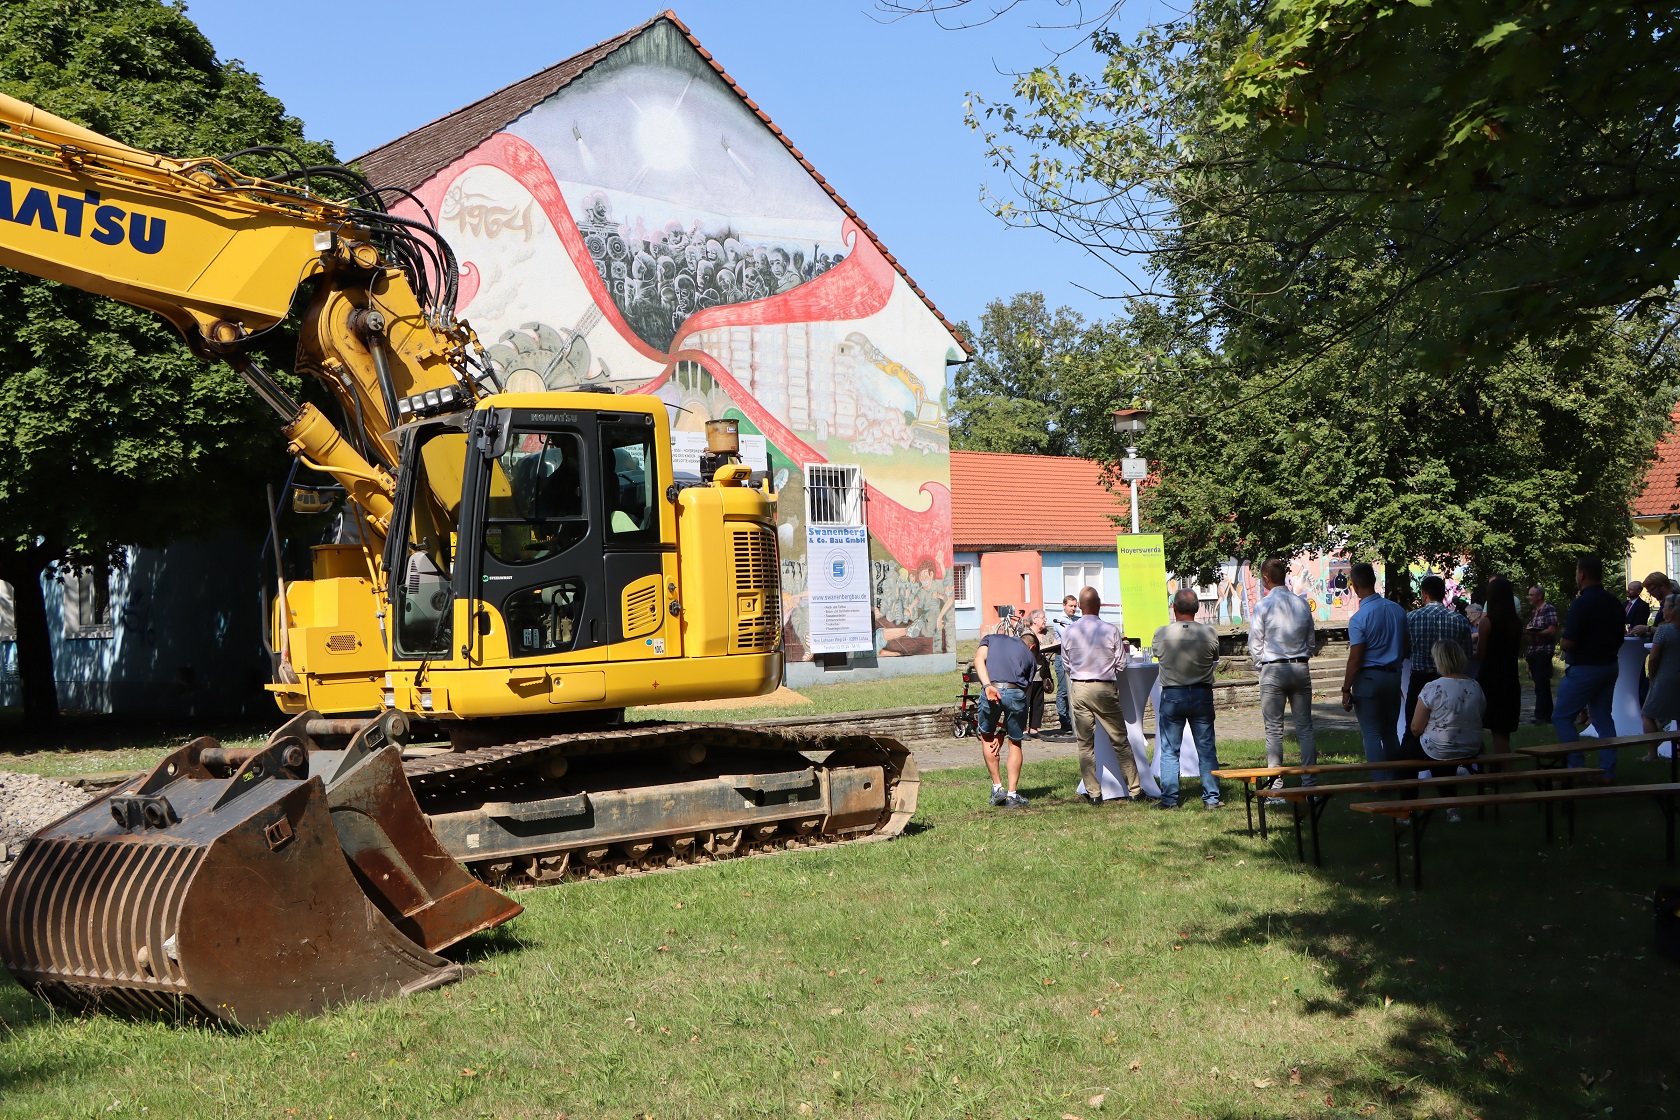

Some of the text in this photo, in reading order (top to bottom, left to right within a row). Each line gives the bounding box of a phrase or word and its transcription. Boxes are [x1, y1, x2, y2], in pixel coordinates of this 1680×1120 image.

[0, 179, 166, 254] ATSU
[531, 413, 578, 422] KOMATSU
[808, 528, 865, 537] Swanenberg
[1120, 547, 1161, 555] Hoyerswerda
[812, 593, 867, 601] www.swanenbergbau.de
